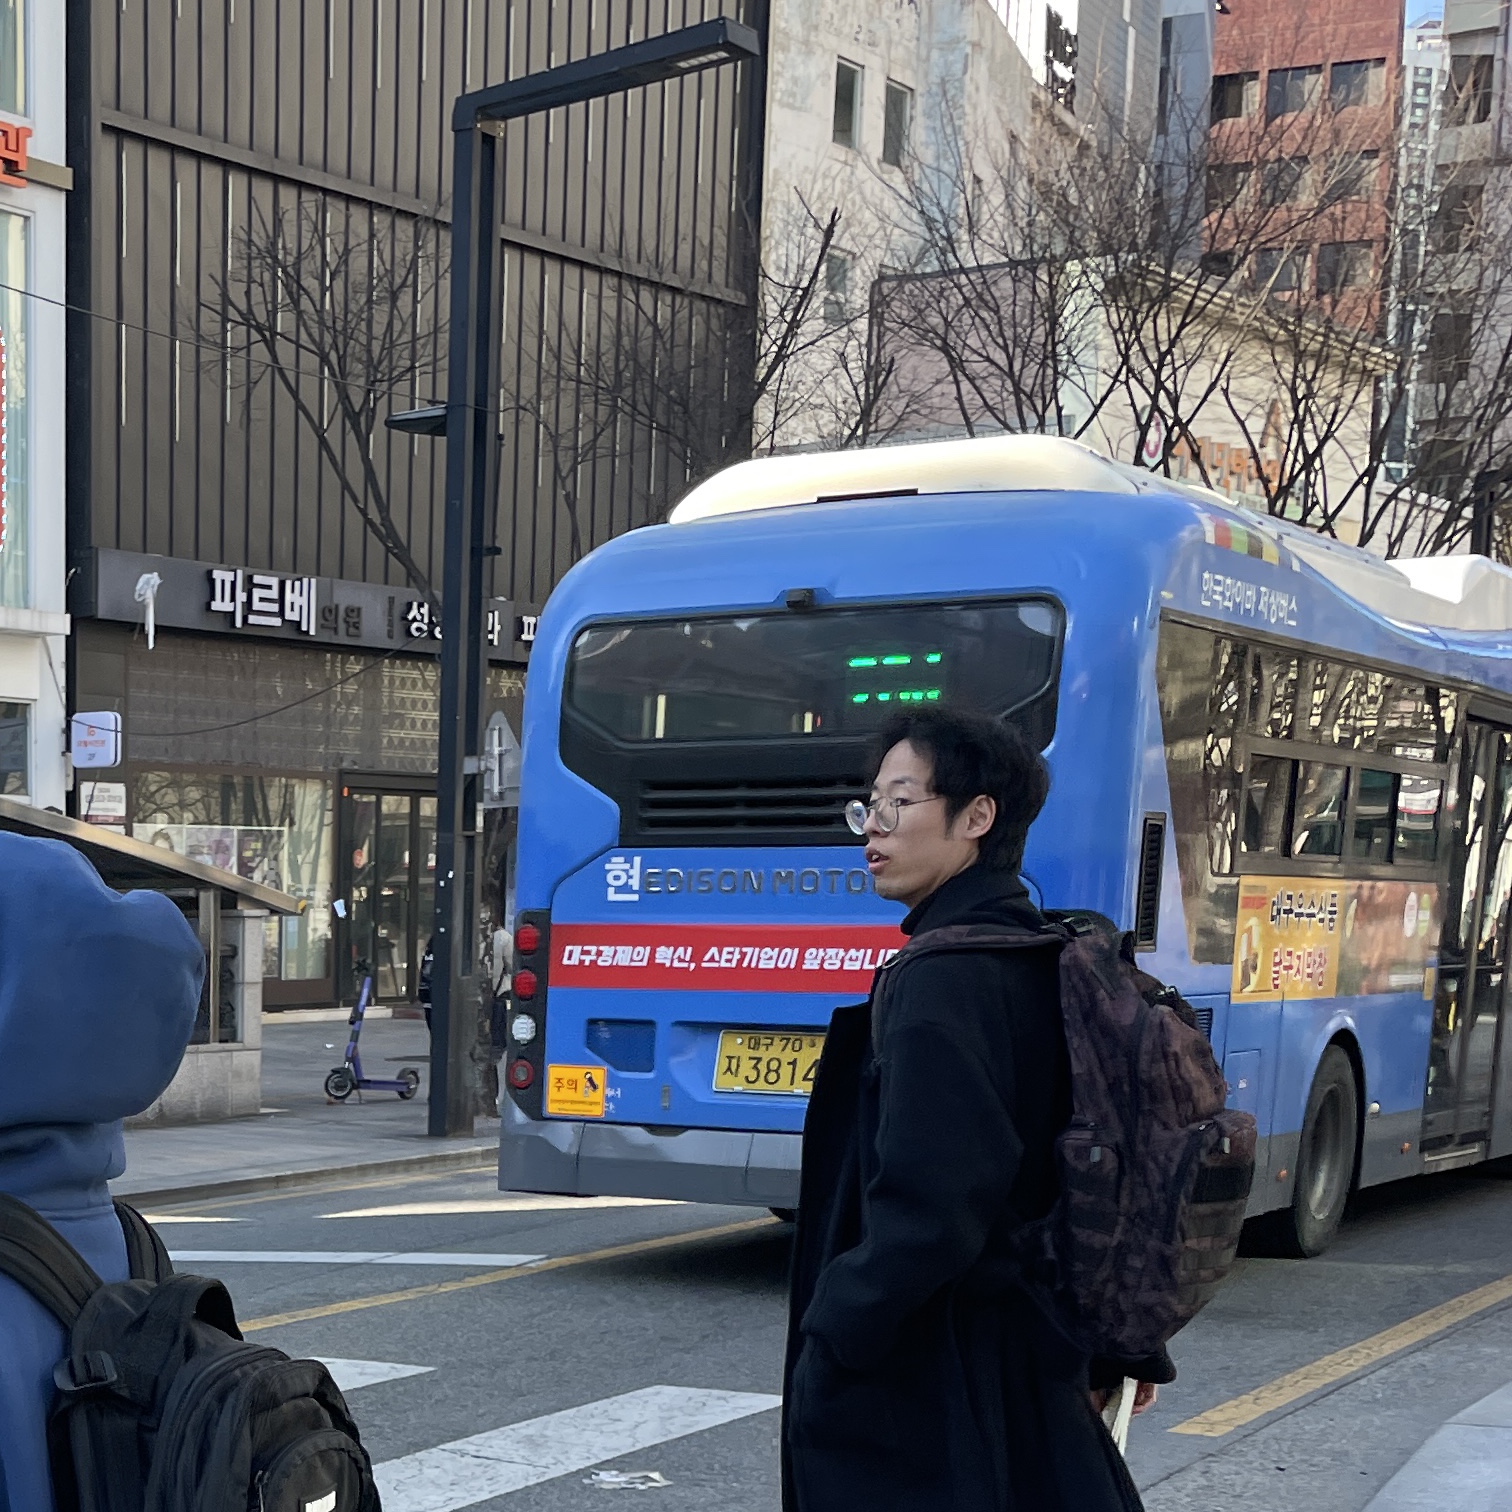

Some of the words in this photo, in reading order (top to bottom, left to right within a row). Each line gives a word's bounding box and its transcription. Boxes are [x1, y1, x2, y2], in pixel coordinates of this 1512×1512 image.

[210, 568, 316, 636] 파르베
[321, 603, 362, 638] 의원
[604, 855, 642, 901] 현
[643, 867, 763, 893] EDISON
[772, 867, 878, 894] MOTO
[561, 945, 650, 967] 대구경제의
[655, 946, 696, 971] 혁신,
[701, 946, 798, 969] 스타기업이
[747, 1036, 774, 1052] 대구
[779, 1037, 803, 1053] 70
[554, 1077, 578, 1093] 주의
